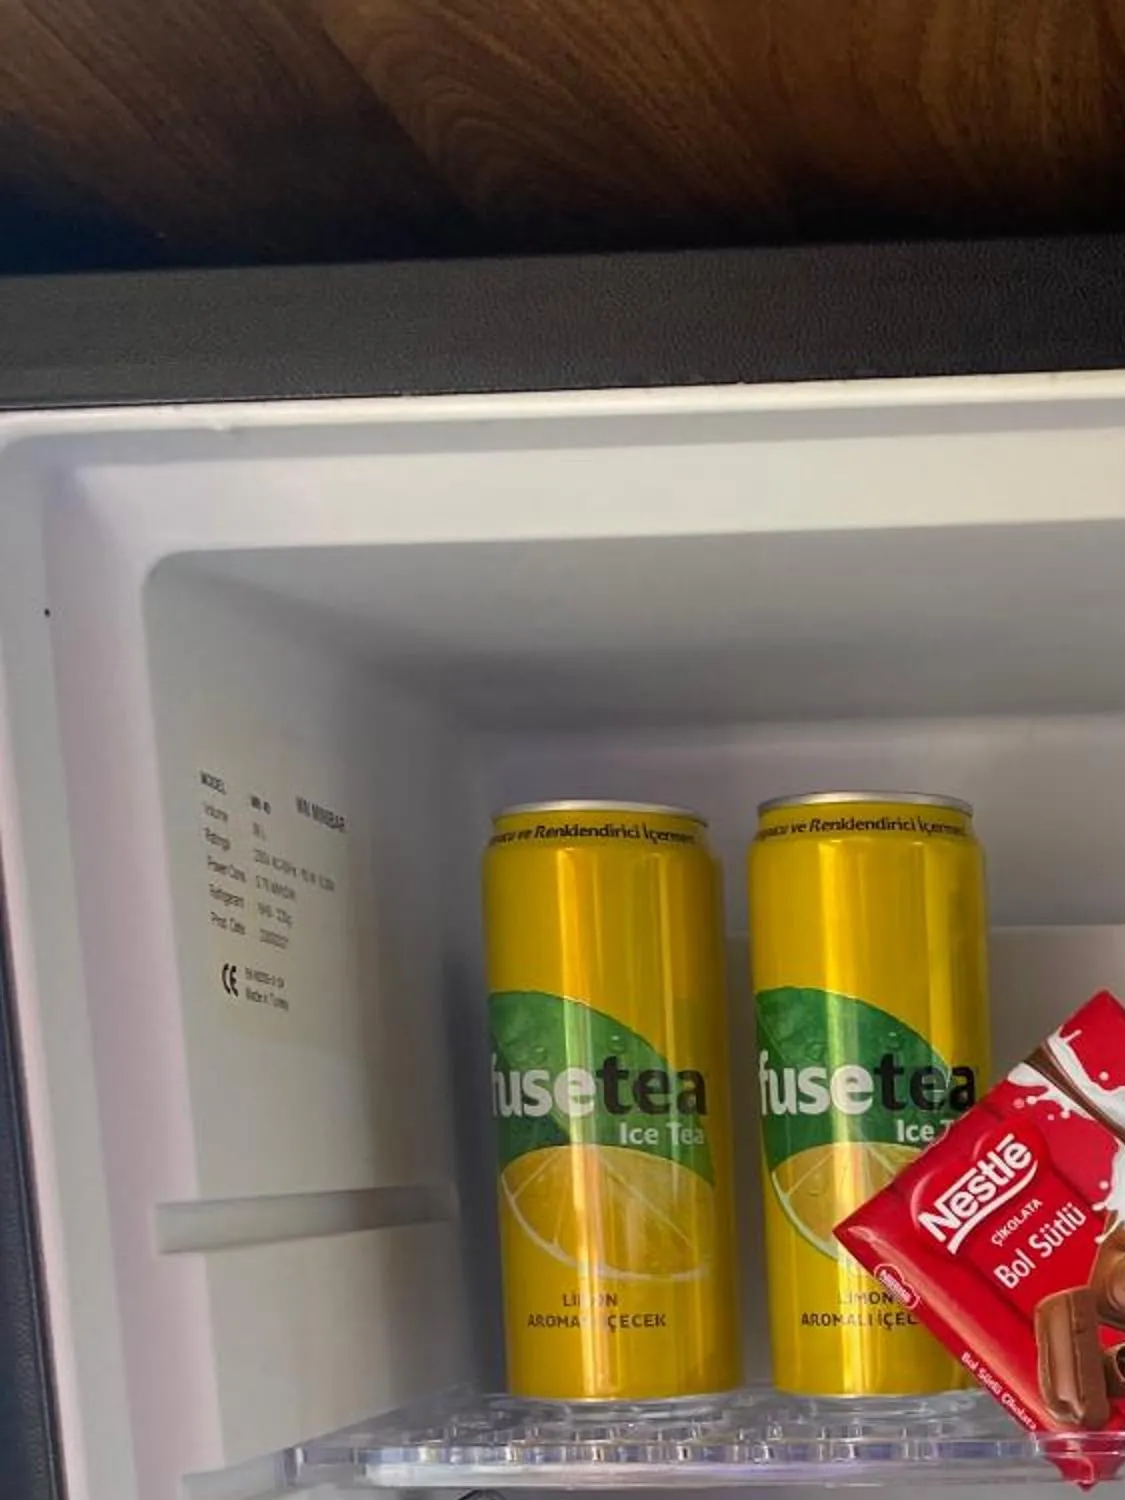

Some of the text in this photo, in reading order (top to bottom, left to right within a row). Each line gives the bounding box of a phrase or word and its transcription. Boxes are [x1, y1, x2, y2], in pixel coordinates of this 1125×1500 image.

[534, 823, 640, 839] Renklendirici
[791, 823, 807, 833] ve
[809, 817, 916, 832] Renklendirici
[619, 1121, 706, 1145] Ice Tea
[897, 1119, 935, 1143] Ice
[993, 1203, 1087, 1289] Bol Sütlü
[563, 1293, 618, 1307] LION
[528, 1313, 666, 1333] AROMA ÇECEK
[801, 1312, 871, 1327] AROMALI
